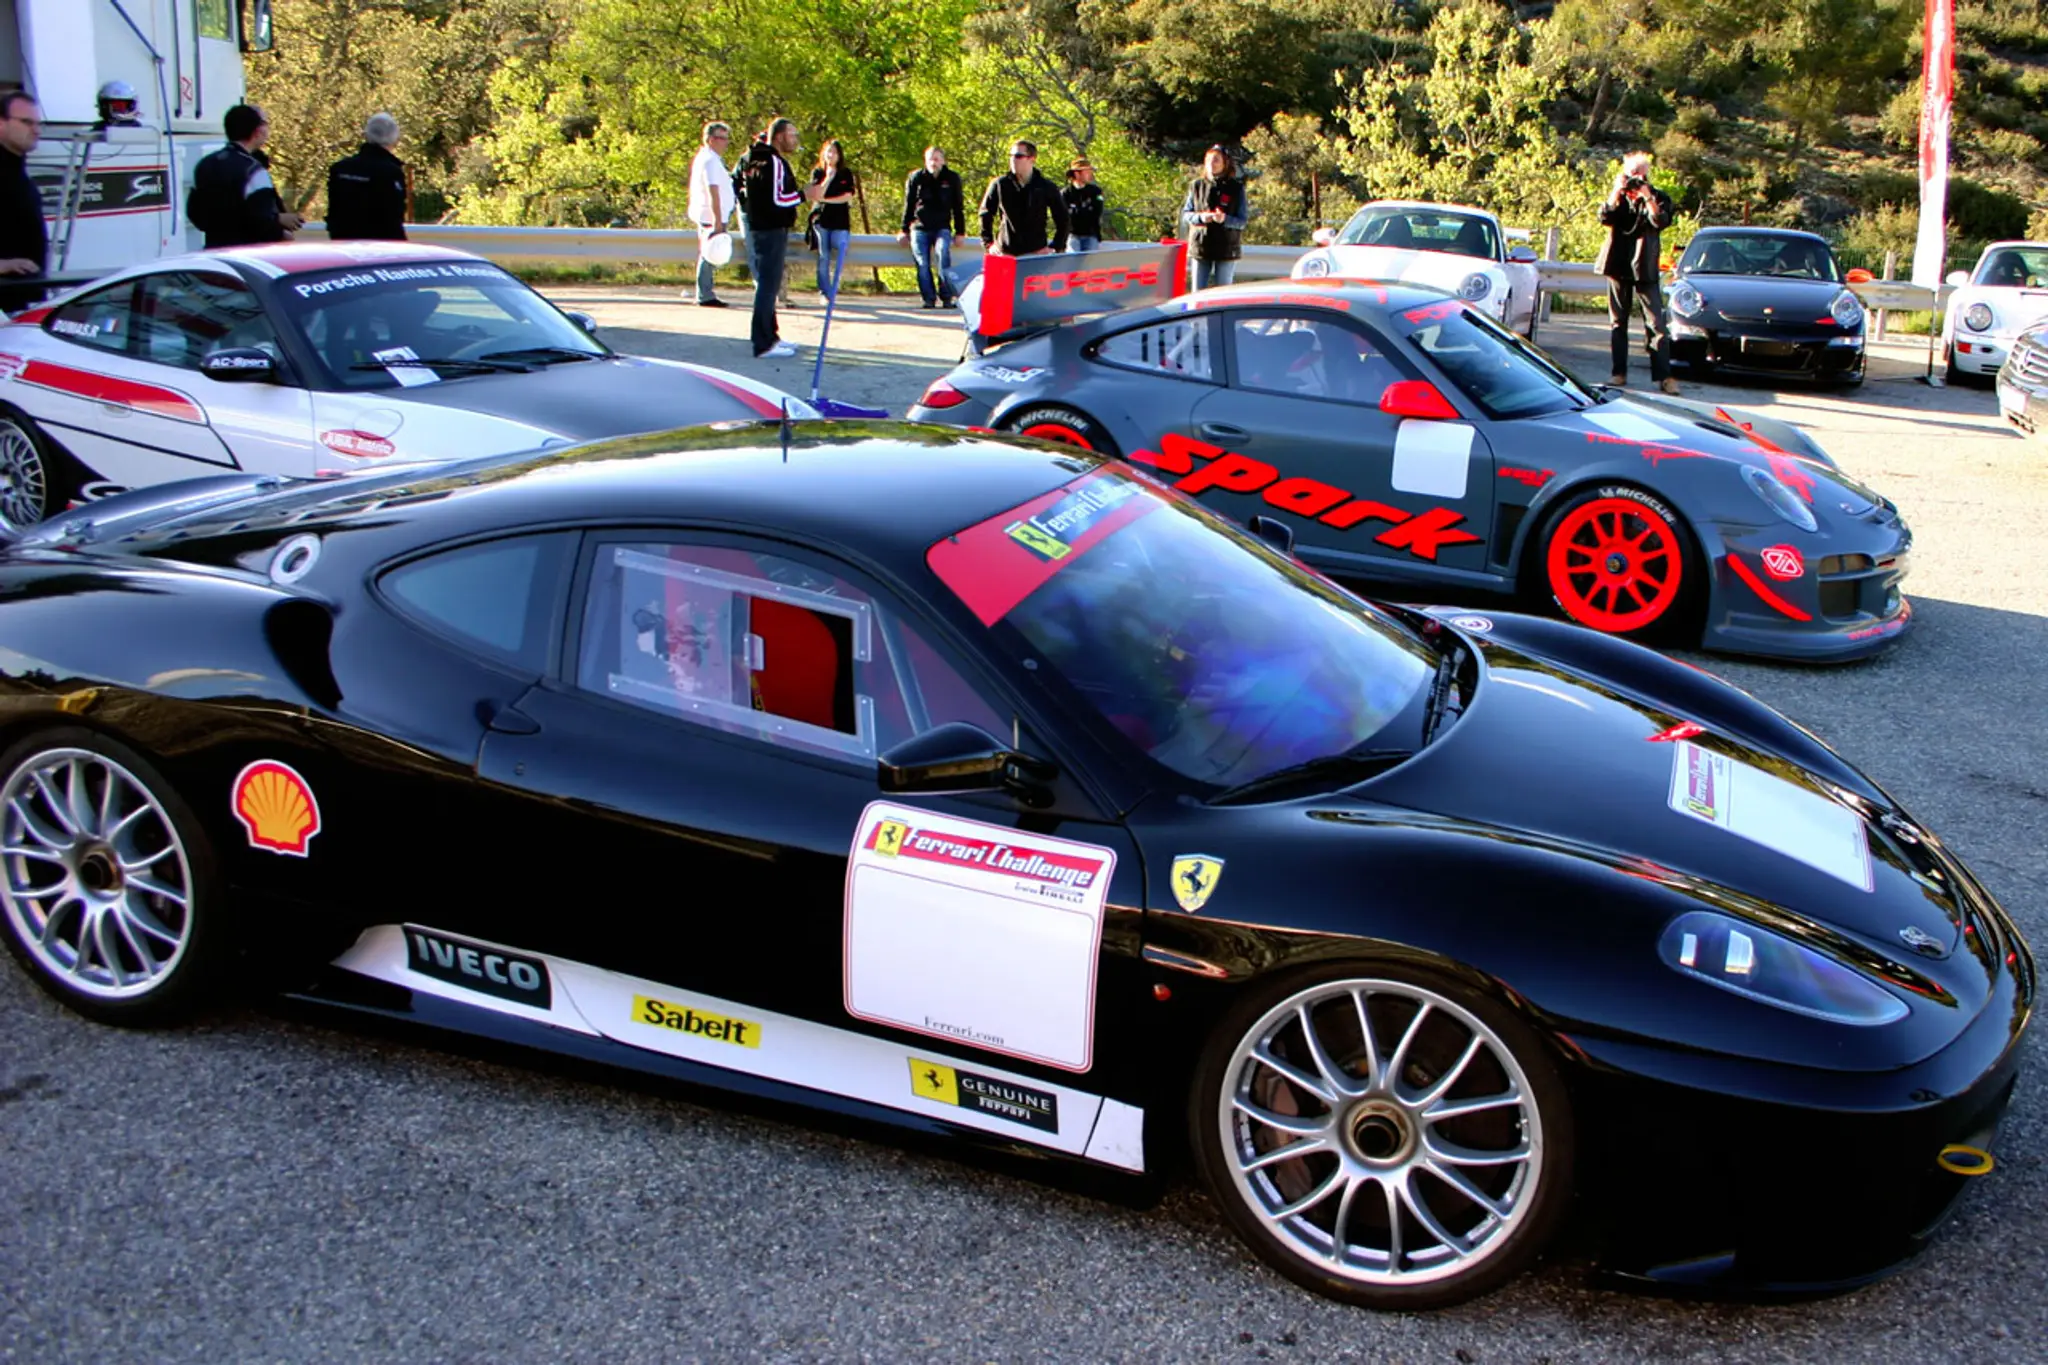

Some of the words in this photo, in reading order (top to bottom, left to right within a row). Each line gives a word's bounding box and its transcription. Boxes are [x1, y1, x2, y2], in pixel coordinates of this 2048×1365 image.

[295, 272, 376, 298] Porsche
[374, 267, 438, 282] Nantes
[1023, 262, 1160, 301] PORSCHE
[1020, 408, 1089, 432] MICHELIN
[1615, 486, 1677, 526] MICHELIN
[902, 827, 986, 863] Ferrari
[987, 843, 1093, 888] Challenge
[414, 934, 541, 991] IVECO
[644, 1000, 748, 1045] Sabelt
[924, 1016, 1004, 1045] Ferrari.com
[961, 1077, 1051, 1111] GENUINE
[979, 1096, 1031, 1120] Ferrari
